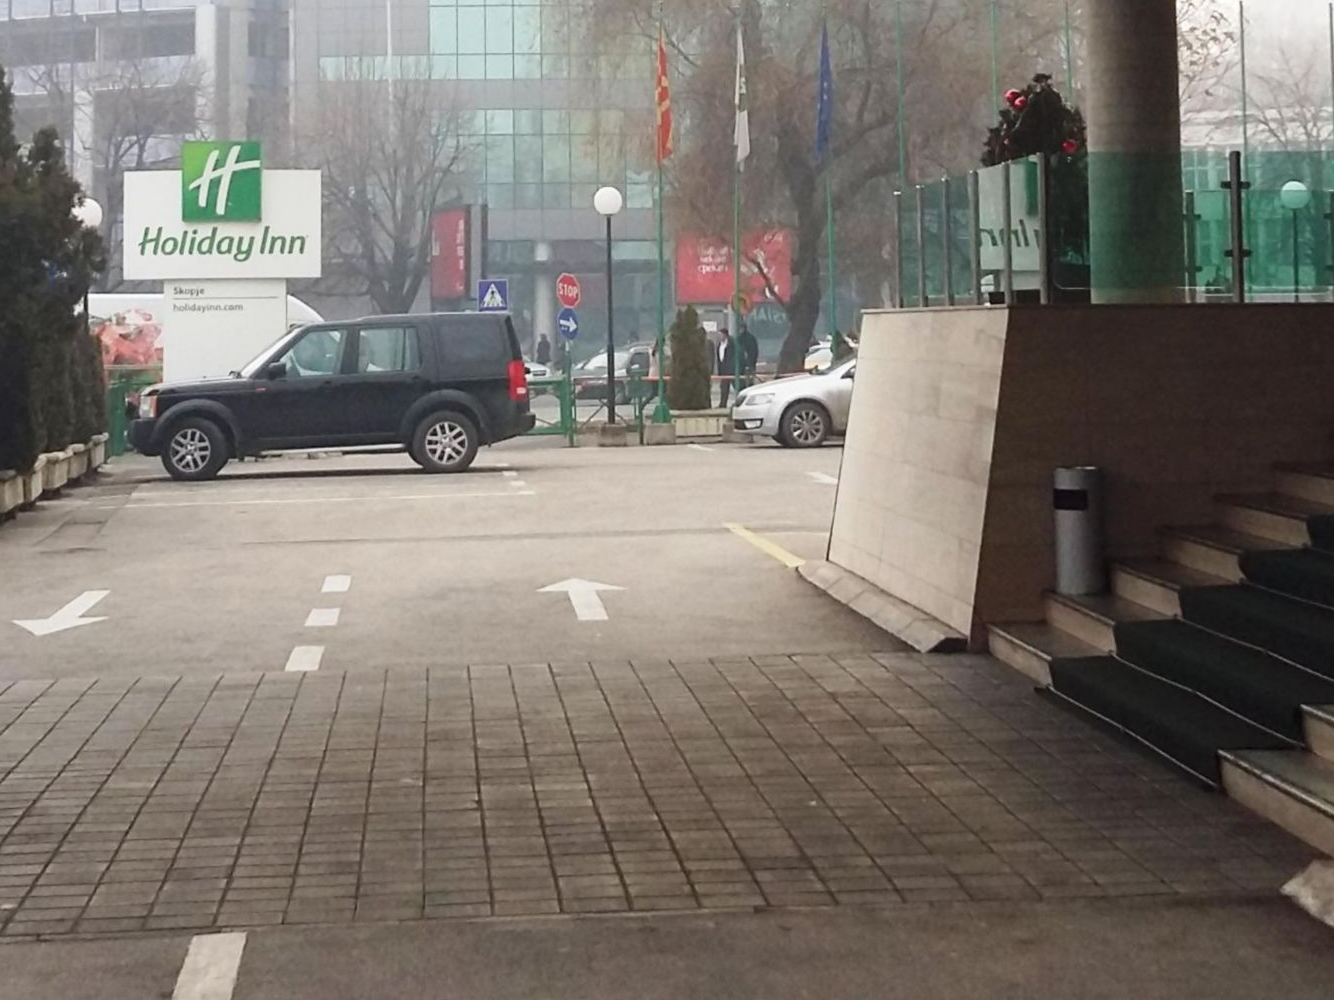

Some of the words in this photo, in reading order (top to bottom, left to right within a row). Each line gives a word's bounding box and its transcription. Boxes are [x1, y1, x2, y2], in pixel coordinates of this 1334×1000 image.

[138, 226, 256, 262] Holiday
[259, 225, 307, 255] Inn
[173, 286, 205, 297] Skopje
[559, 282, 578, 299] STOP
[172, 303, 244, 313] holidayinn.com
